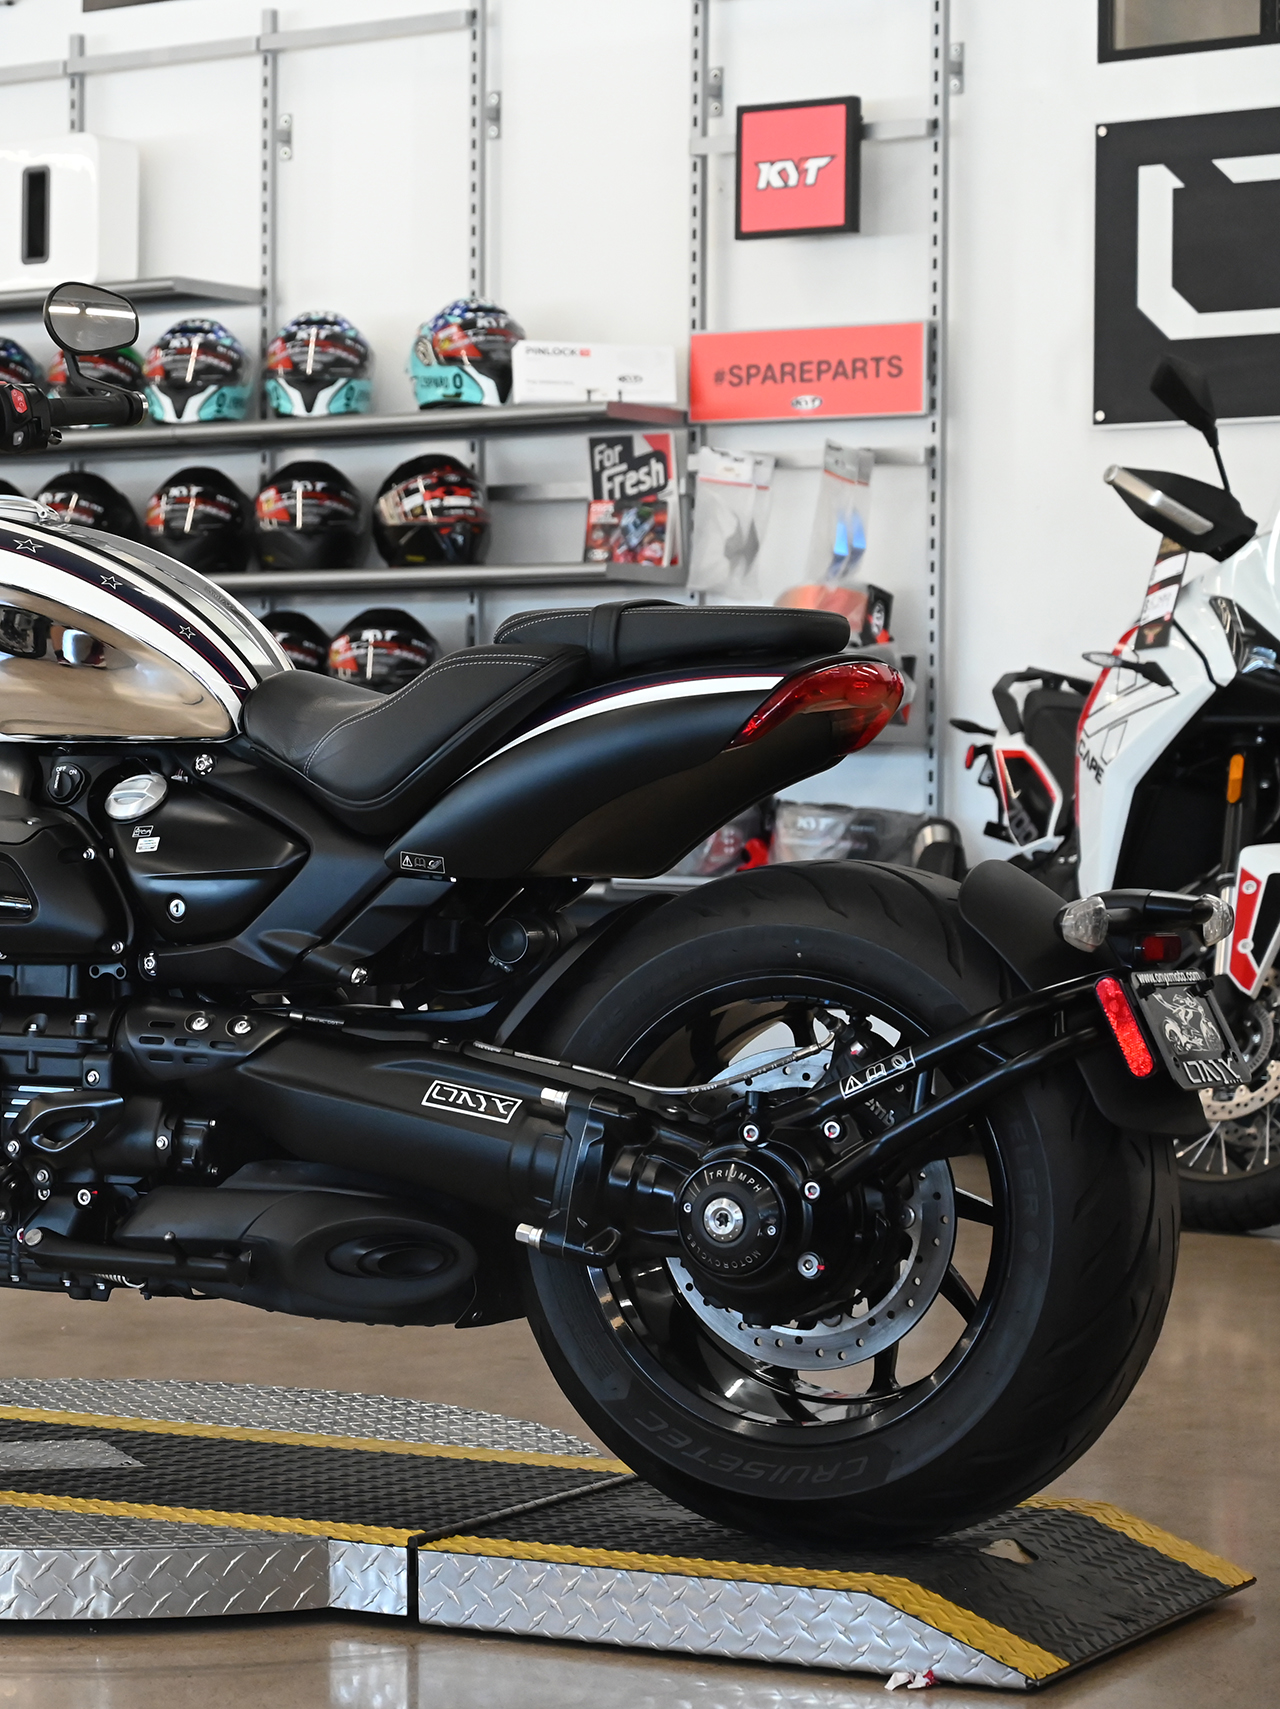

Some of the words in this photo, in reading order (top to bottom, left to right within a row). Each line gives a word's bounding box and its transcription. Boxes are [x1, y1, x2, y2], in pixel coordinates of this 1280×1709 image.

[755, 154, 837, 191] KYT
[714, 355, 904, 388] #SPAREPARTS
[593, 442, 624, 472] For
[601, 457, 666, 501] Fresh
[1182, 1056, 1242, 1084] ONYX
[431, 1085, 514, 1114] ONYX
[708, 1169, 763, 1194] TRIUMPH
[686, 1232, 763, 1270] MOTORCYCLES
[633, 1410, 869, 1485] CRUISETEC
